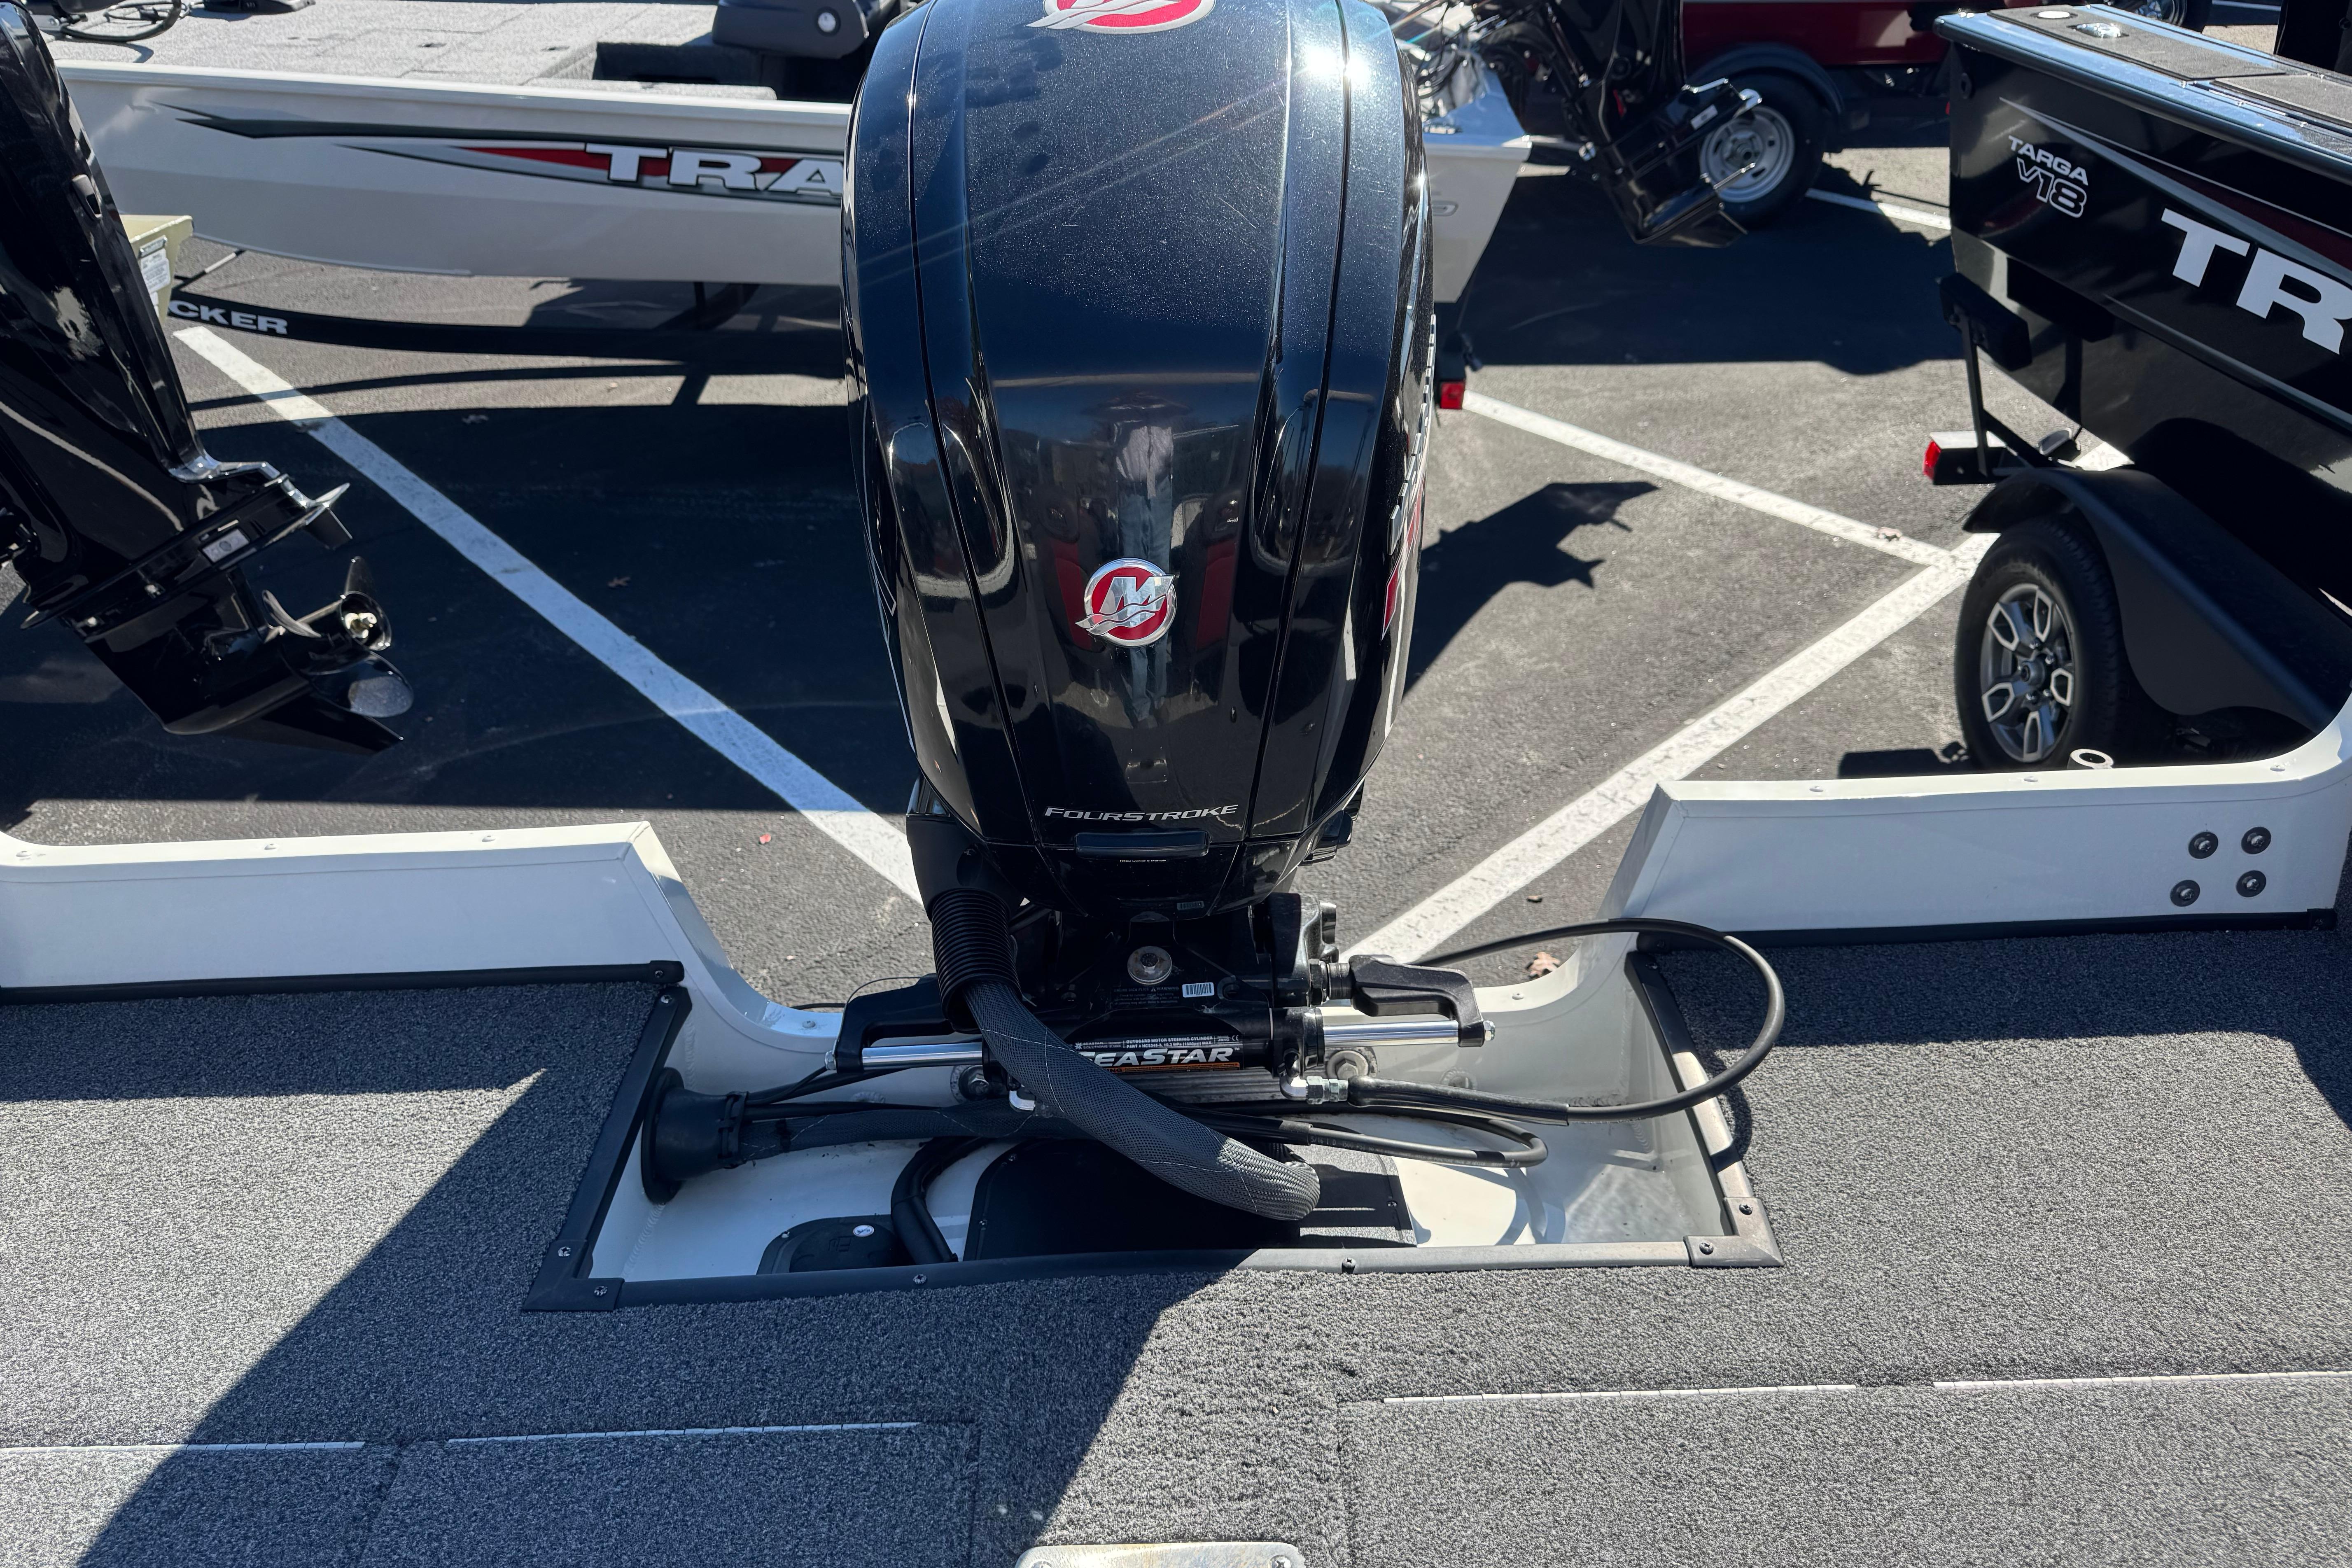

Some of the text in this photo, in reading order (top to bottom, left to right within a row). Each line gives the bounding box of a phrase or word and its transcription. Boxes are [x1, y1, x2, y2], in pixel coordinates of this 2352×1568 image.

[2009, 135, 2088, 186] TARGA
[2017, 157, 2087, 218] V18
[1045, 804, 1239, 821] FOURSTROKE
